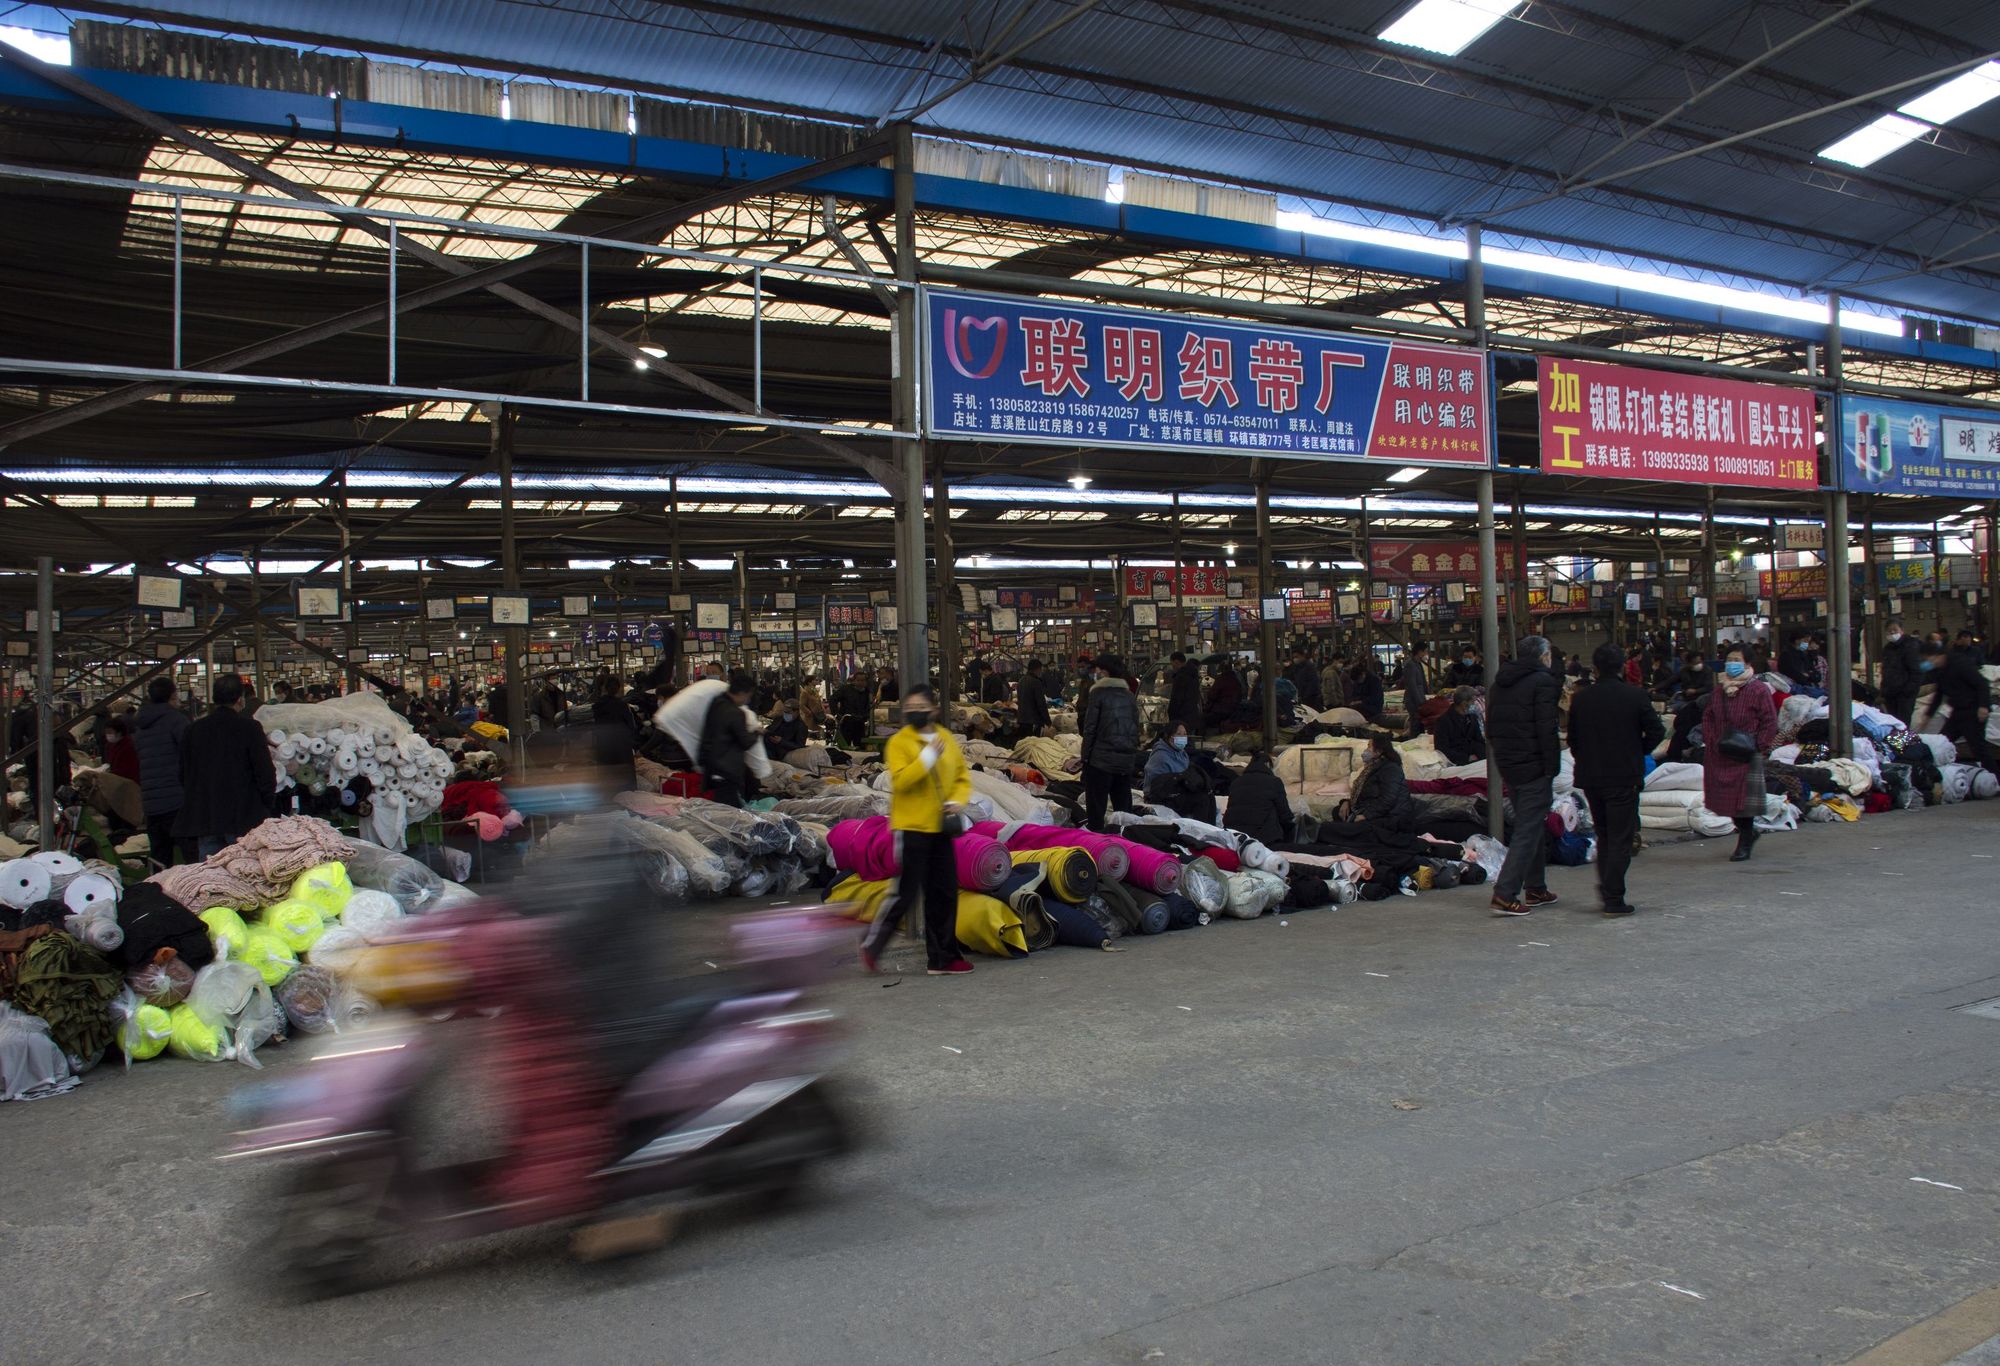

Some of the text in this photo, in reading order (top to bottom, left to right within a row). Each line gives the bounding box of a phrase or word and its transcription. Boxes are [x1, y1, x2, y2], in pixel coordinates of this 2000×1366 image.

[1019, 317, 1365, 414] 联明织带厂
[1392, 363, 1475, 395] 联明织带
[1068, 403, 1139, 420] 15867420257
[1394, 399, 1477, 430] 用心编织
[1549, 362, 1584, 469] 加工
[1714, 456, 1775, 477] 13008915051
[1778, 459, 1814, 481] 上门服务
[1412, 553, 1514, 571] 鑫金鑫
